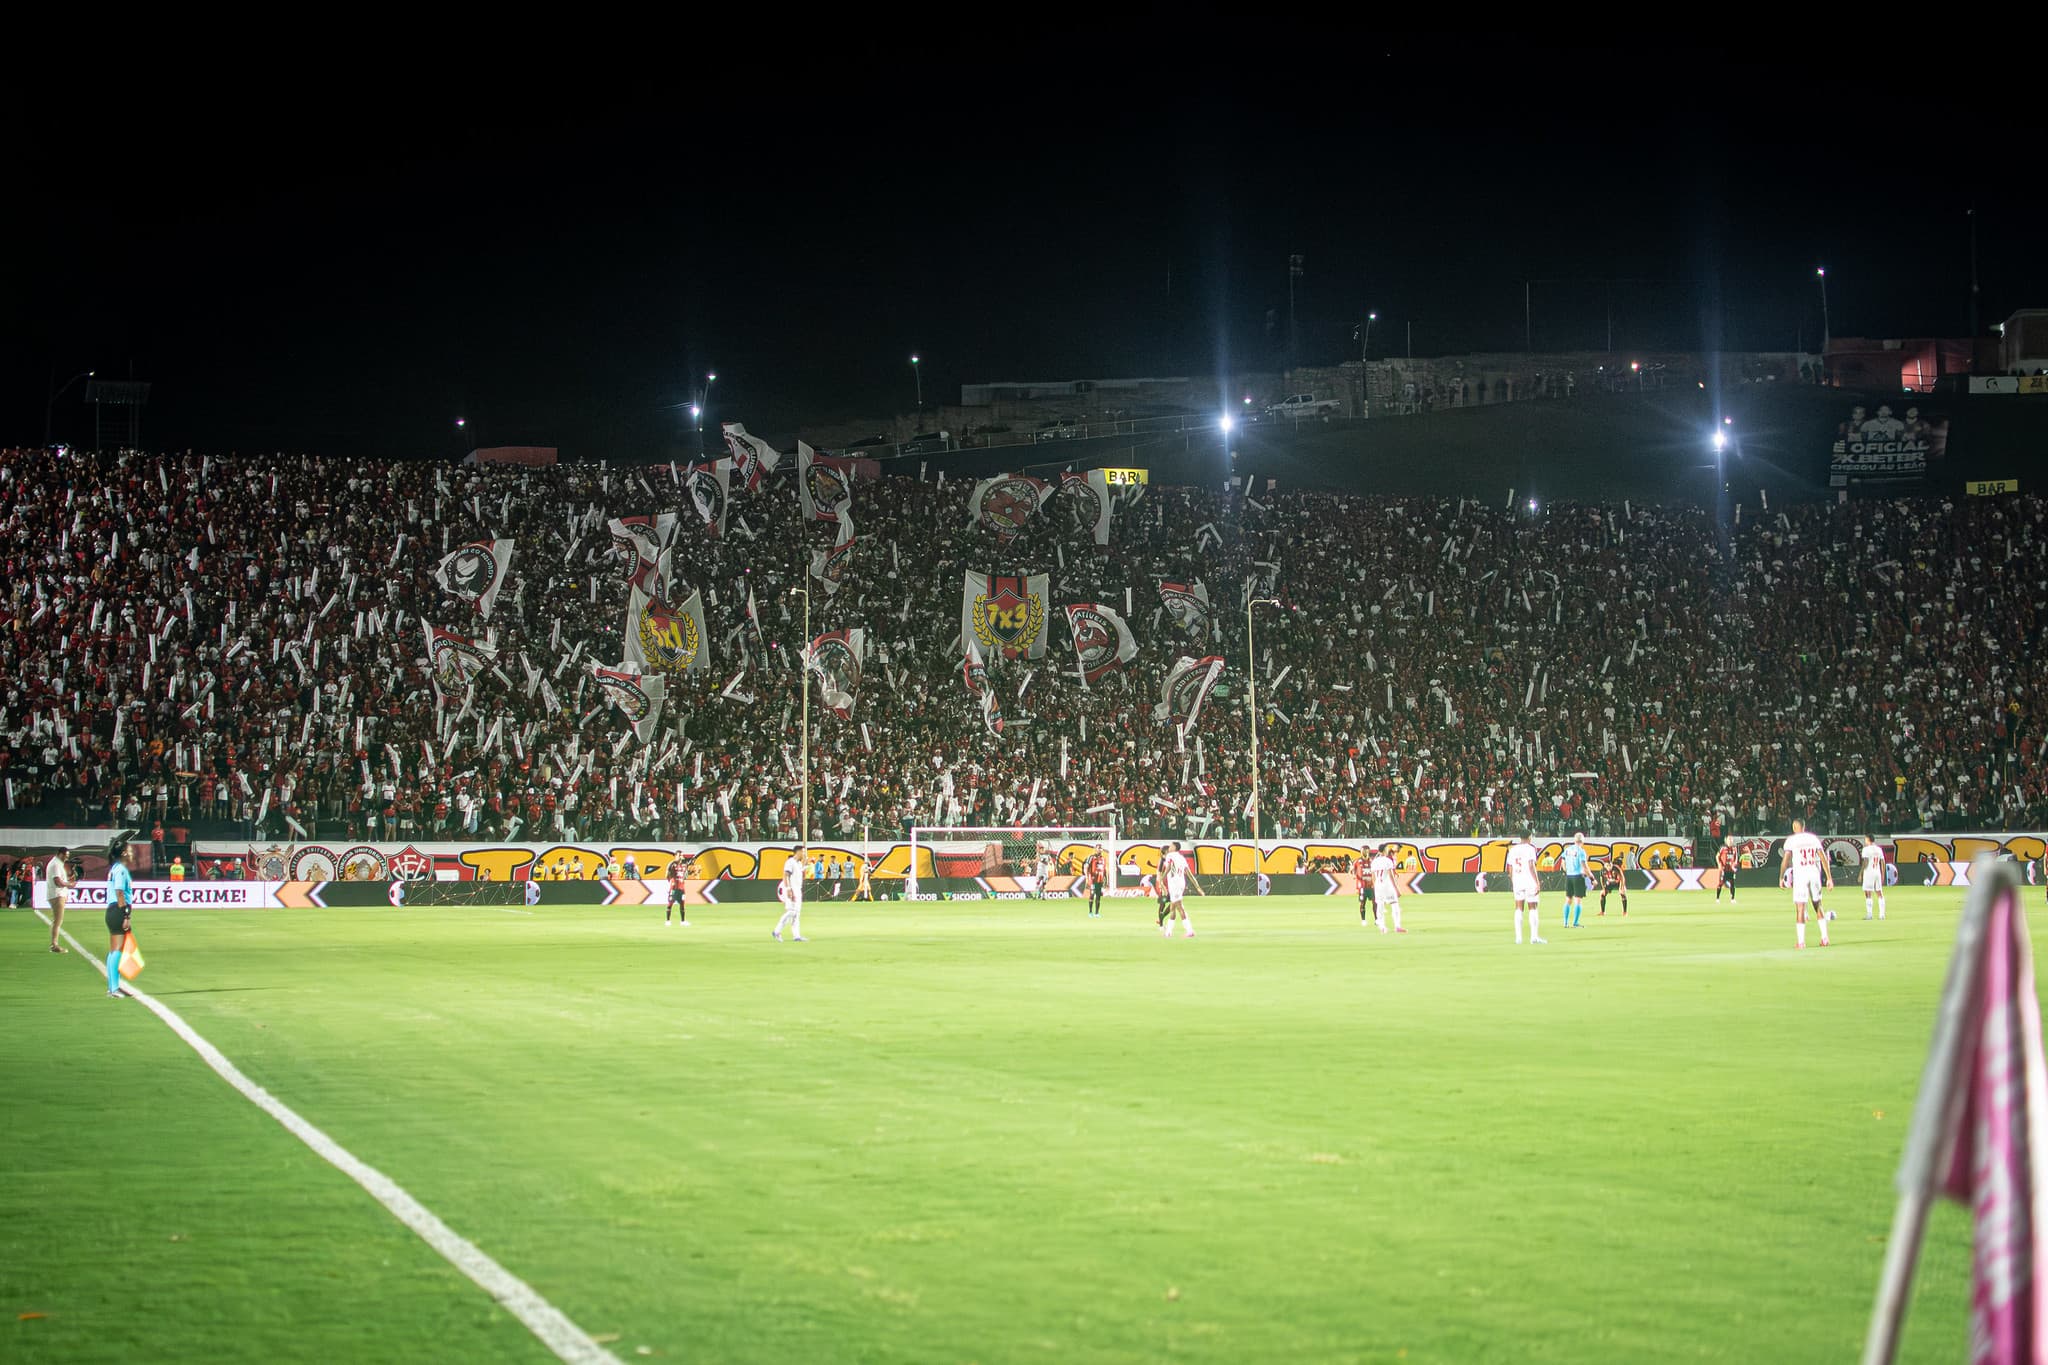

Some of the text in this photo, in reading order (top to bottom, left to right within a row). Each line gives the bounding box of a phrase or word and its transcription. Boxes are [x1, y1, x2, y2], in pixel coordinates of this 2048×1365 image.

[1849, 440, 1931, 454] OFICIAL
[1109, 471, 1137, 482] BAR
[1977, 482, 2005, 495] BAR
[1800, 848, 1815, 866] 33
[67, 887, 246, 904] RACMO É CRIME!
[996, 892, 1026, 900] SICOOB
